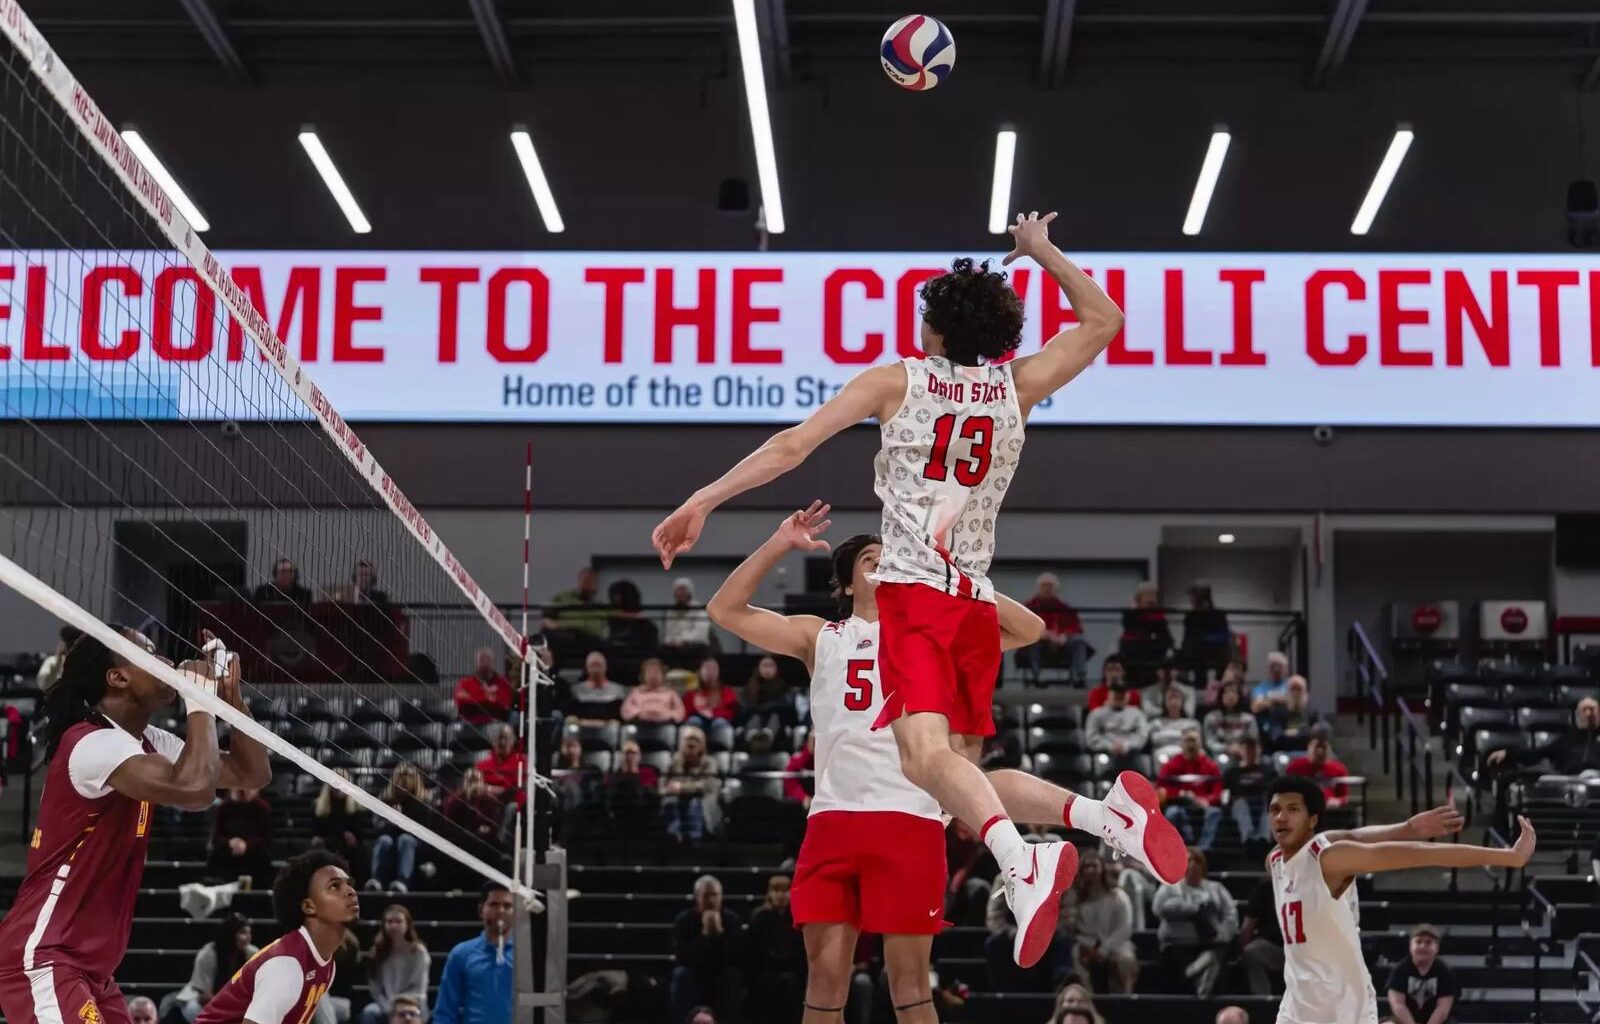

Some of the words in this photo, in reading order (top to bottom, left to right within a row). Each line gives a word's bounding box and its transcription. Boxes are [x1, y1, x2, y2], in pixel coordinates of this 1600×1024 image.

[0, 265, 388, 364] LCOME
[420, 267, 550, 364] TO
[584, 268, 784, 364] THE
[1305, 270, 1600, 367] CENT
[503, 376, 594, 406] Home
[606, 376, 637, 406] of
[649, 376, 702, 407] the
[714, 376, 784, 407] Ohio
[923, 413, 995, 487] 13
[844, 659, 875, 711] 5
[1281, 901, 1307, 944] 17
